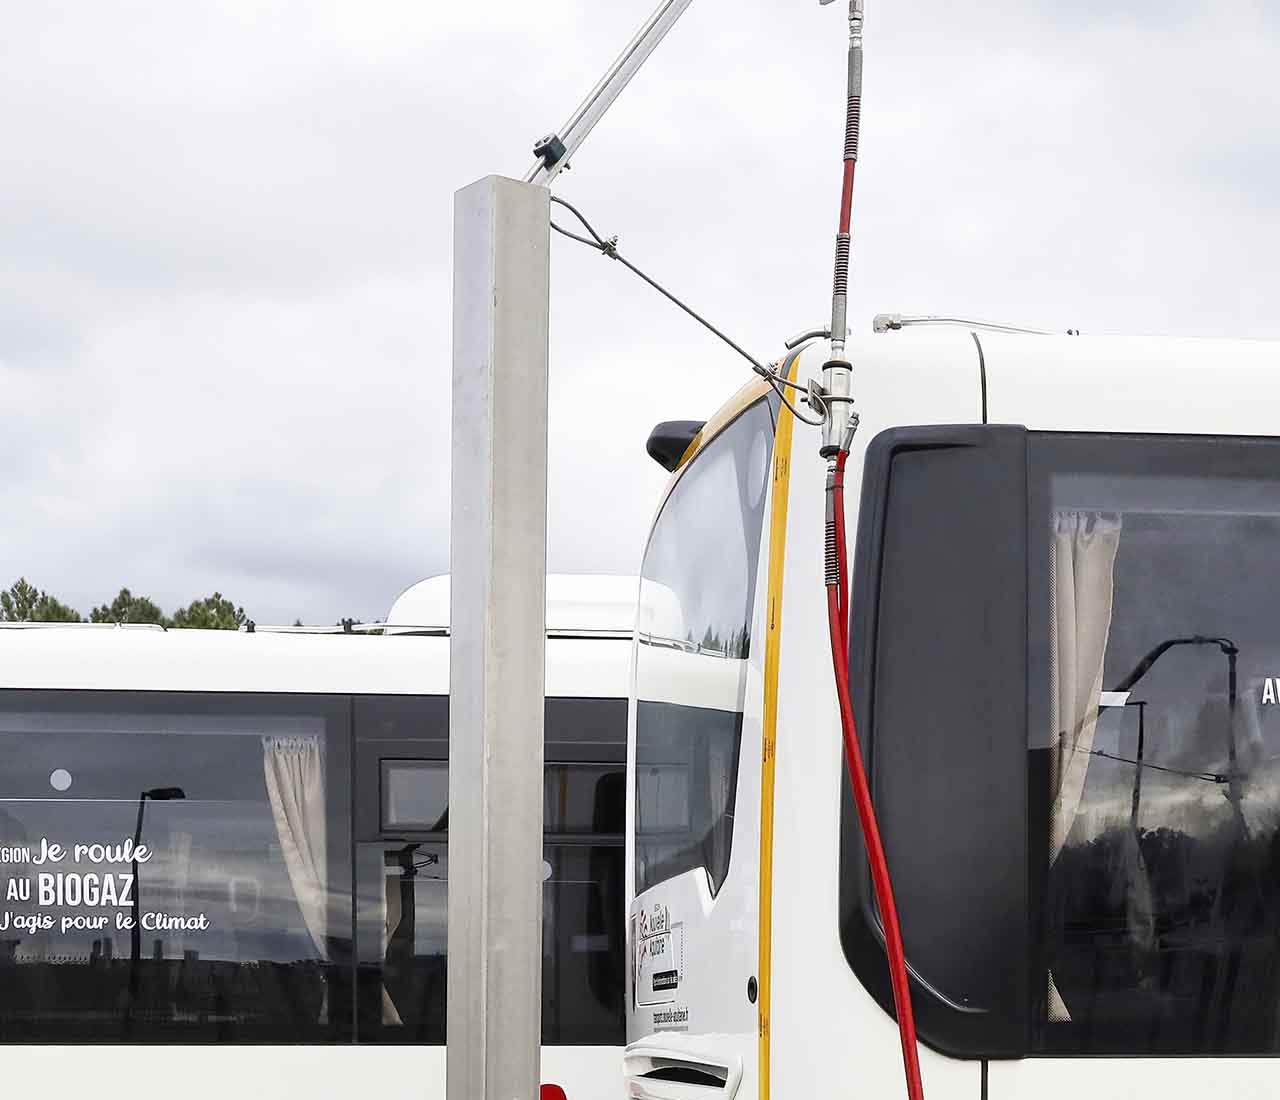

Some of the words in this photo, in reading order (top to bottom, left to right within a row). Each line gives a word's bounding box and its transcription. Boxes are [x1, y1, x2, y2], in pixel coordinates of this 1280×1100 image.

[32, 837, 66, 865] Je
[74, 837, 153, 864] roule
[6, 878, 30, 901] AU
[38, 872, 135, 907] BIOGAZ
[61, 915, 109, 934] pour
[115, 911, 137, 930] le
[141, 912, 210, 930] Climat
